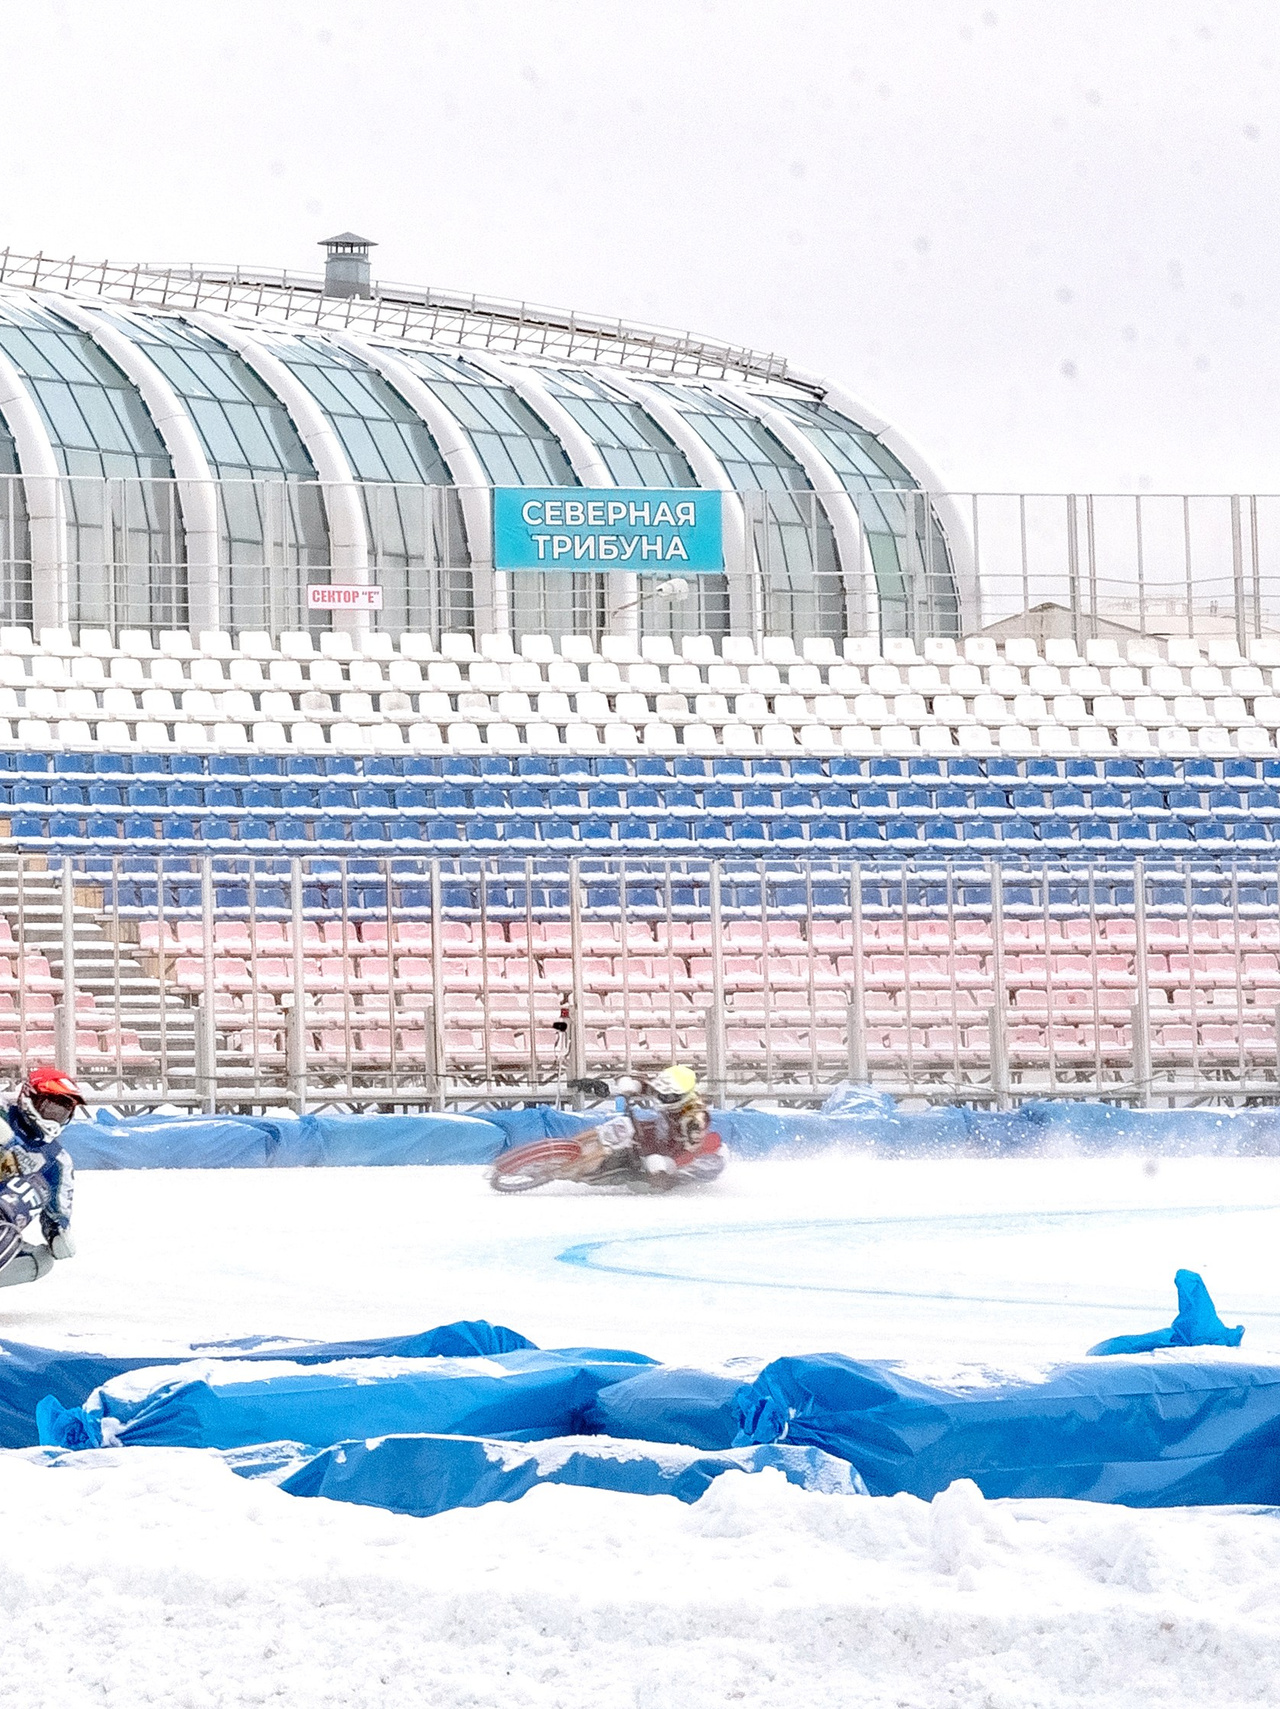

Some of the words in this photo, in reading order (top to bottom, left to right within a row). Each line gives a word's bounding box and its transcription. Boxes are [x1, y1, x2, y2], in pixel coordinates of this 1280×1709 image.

[523, 501, 696, 526] СЕВЕРНАЯ
[531, 535, 689, 560] ТРИБУНА
[312, 589, 360, 604] СЕКТОР
